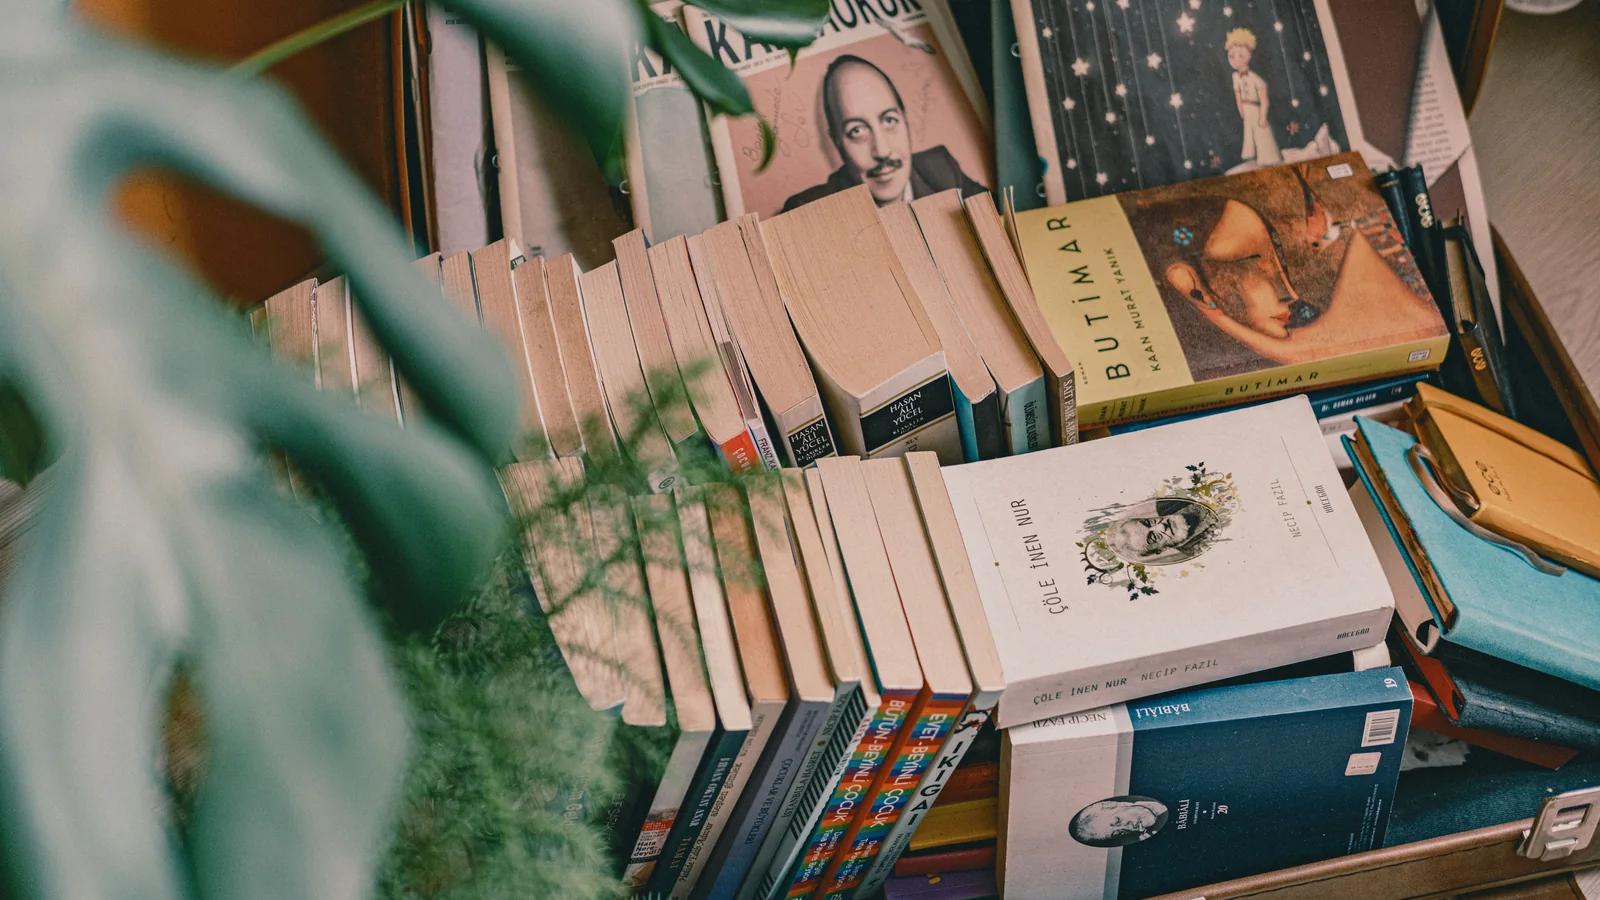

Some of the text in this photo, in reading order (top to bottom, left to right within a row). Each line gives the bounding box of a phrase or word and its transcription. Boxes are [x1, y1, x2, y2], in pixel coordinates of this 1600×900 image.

[1047, 217, 1130, 380] BUTİMAR
[1103, 247, 1161, 371] KAAN MURAT YANIK
[1225, 372, 1319, 395] BUTİMAR
[890, 391, 921, 413] HASAN
[791, 421, 823, 443] HASAN
[759, 437, 774, 460] FRANZ
[1269, 478, 1289, 506] FAZIL
[1010, 498, 1068, 614] ÇÖLE İNEN NUR
[1033, 659, 1219, 705] ÇÖLE İNEN NUR NECİP FAZIL
[1384, 677, 1398, 689] 19
[908, 740, 964, 826] IKIGAI
[832, 784, 862, 822] ÇOCUK
[869, 787, 904, 829] ÇOCUK
[1216, 804, 1229, 815] 20
[821, 828, 834, 842] Tina
